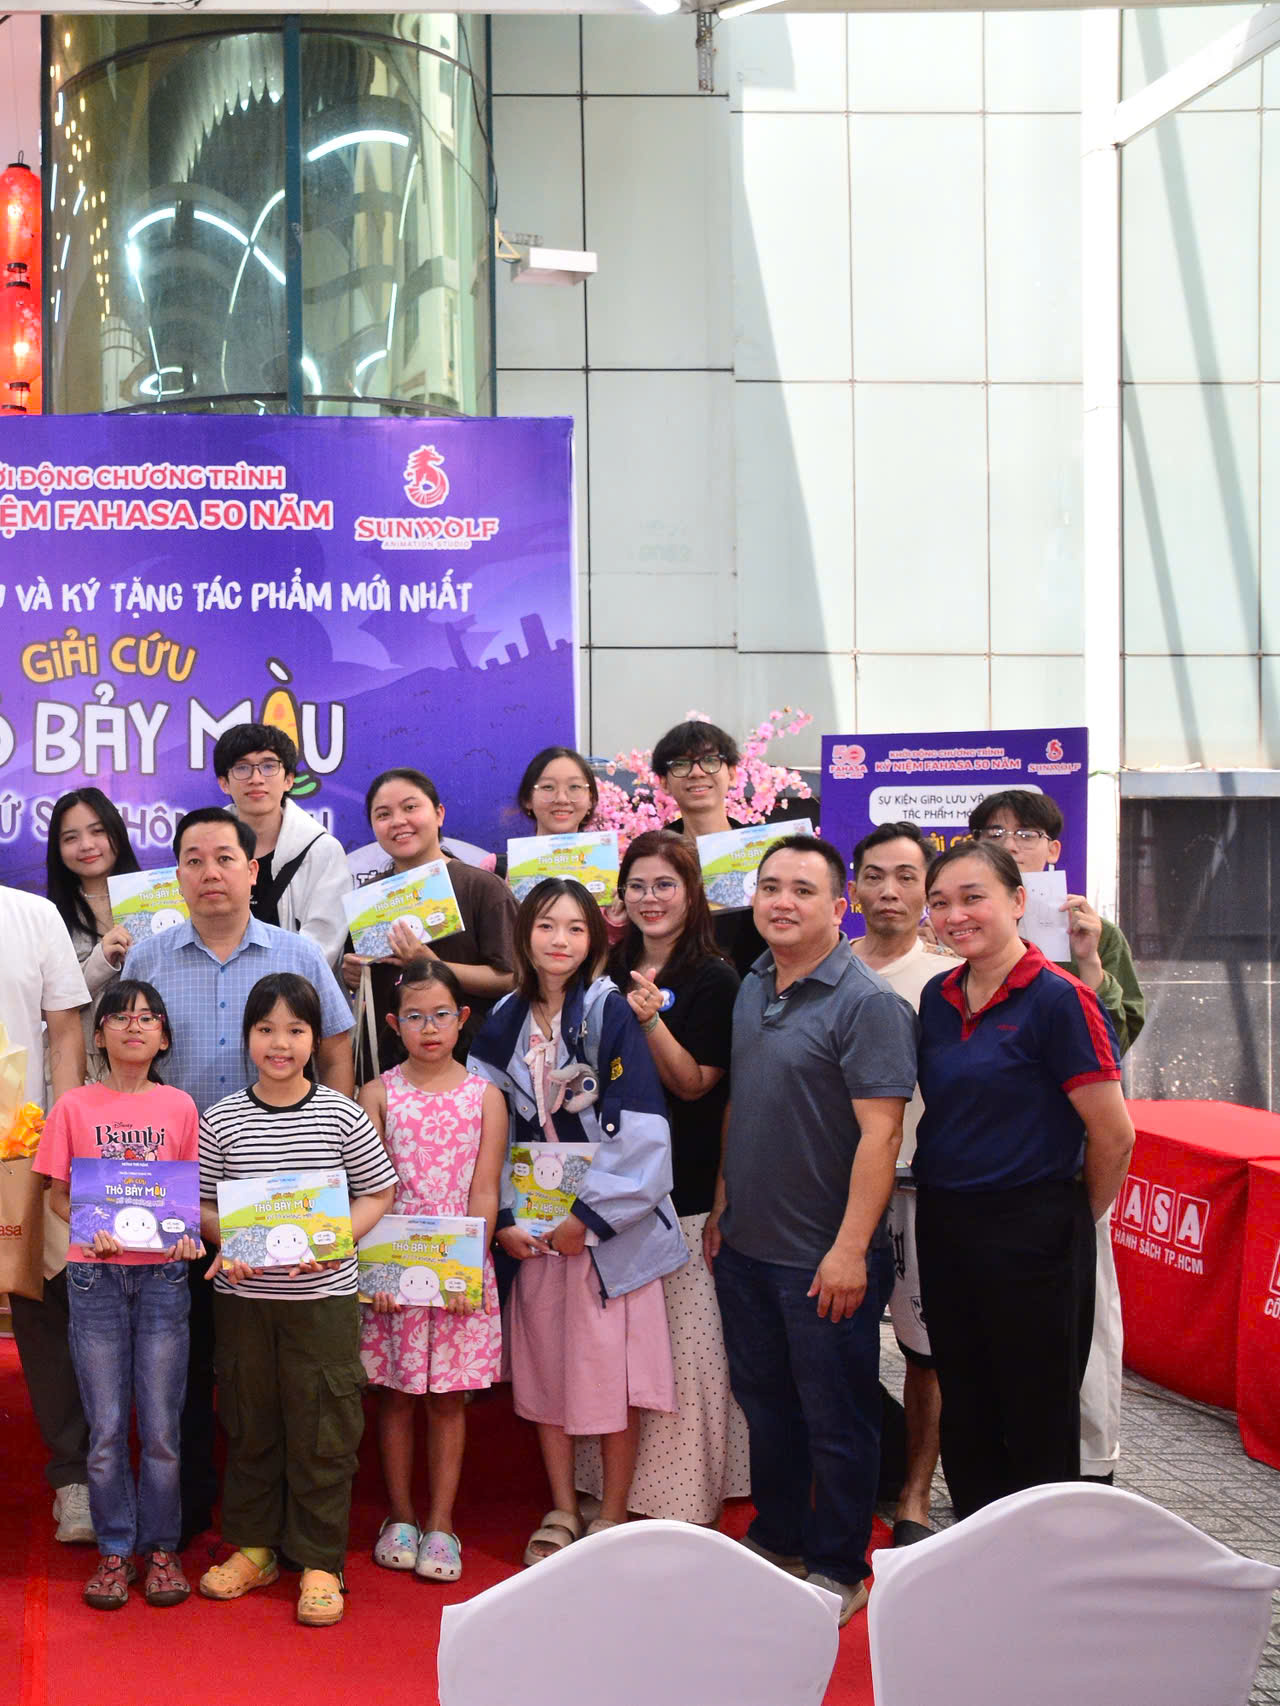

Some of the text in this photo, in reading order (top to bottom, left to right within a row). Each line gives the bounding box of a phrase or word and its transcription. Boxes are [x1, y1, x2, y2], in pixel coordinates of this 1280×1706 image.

[20, 463, 90, 494] ĐỘNG
[95, 466, 204, 488] CHƯƠNG
[208, 462, 284, 488] TRÌNH
[58, 503, 197, 529] FAHASA
[204, 502, 244, 528] 50
[253, 494, 332, 528] NĂM
[355, 517, 498, 540] SUNWOLF
[437, 540, 470, 548] STUDIO
[16, 576, 52, 611] VÀ
[62, 577, 101, 611] KÝ
[110, 576, 182, 618] TẶNG
[193, 575, 242, 612] TÁC
[251, 568, 332, 612] PHẨM
[341, 574, 391, 612] MỚI
[400, 569, 472, 612] NHẤT
[110, 630, 197, 683] CỨU
[34, 682, 169, 776] BẢY
[829, 765, 868, 773] FAHASA
[875, 757, 1021, 774] KỶ NIỆM FAHASA 50 NĂM
[878, 795, 891, 805] SỰ
[946, 794, 967, 804] LƯU
[95, 1125, 165, 1147] Bambi
[105, 1184, 124, 1195] THỎ
[125, 1184, 144, 1197] BẢY
[254, 1202, 272, 1212] THỎ
[1124, 1184, 1201, 1246] ASA
[1114, 1229, 1204, 1274] HÀNH SÁCH TP.HCM
